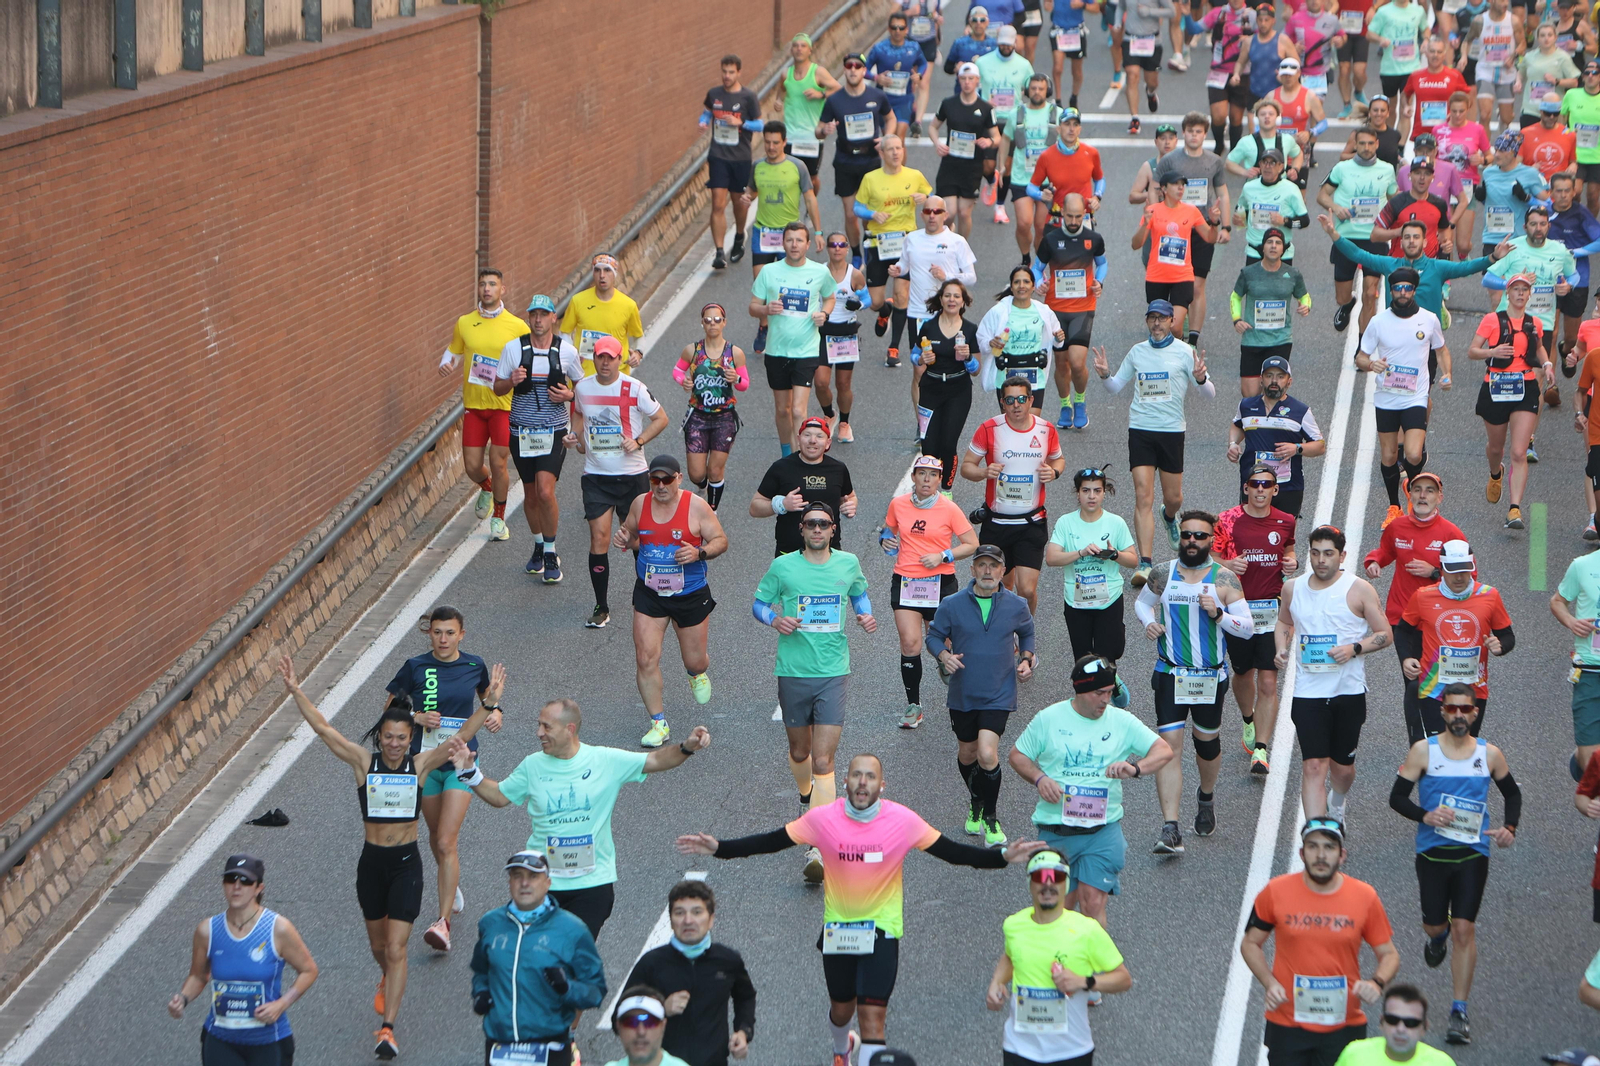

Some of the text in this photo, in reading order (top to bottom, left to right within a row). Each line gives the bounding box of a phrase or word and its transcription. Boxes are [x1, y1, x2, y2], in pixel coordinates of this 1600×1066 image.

[884, 199, 910, 207] SEVILLA
[1397, 367, 1418, 376] ZURICH
[693, 372, 728, 390] Exotic
[1147, 374, 1167, 382] ZURICH
[700, 390, 726, 407] Run
[911, 520, 927, 531] A2
[813, 597, 837, 605] ZURICH
[1174, 594, 1189, 602] Luisiana
[1309, 635, 1333, 643] ZURICH
[1310, 649, 1324, 657] 5538
[1190, 668, 1213, 676] ZURICH
[440, 720, 463, 728] ZURICH
[1080, 788, 1104, 797] ZURICH
[1078, 802, 1093, 810] 7808
[1456, 800, 1480, 812] ZURICH
[548, 815, 591, 825] SEVILLA'24
[561, 837, 588, 846] ZURICH
[851, 843, 883, 851] FLORES
[838, 852, 865, 862] RUN
[1311, 980, 1341, 988] ZURICH
[229, 984, 258, 994] ZURICH
